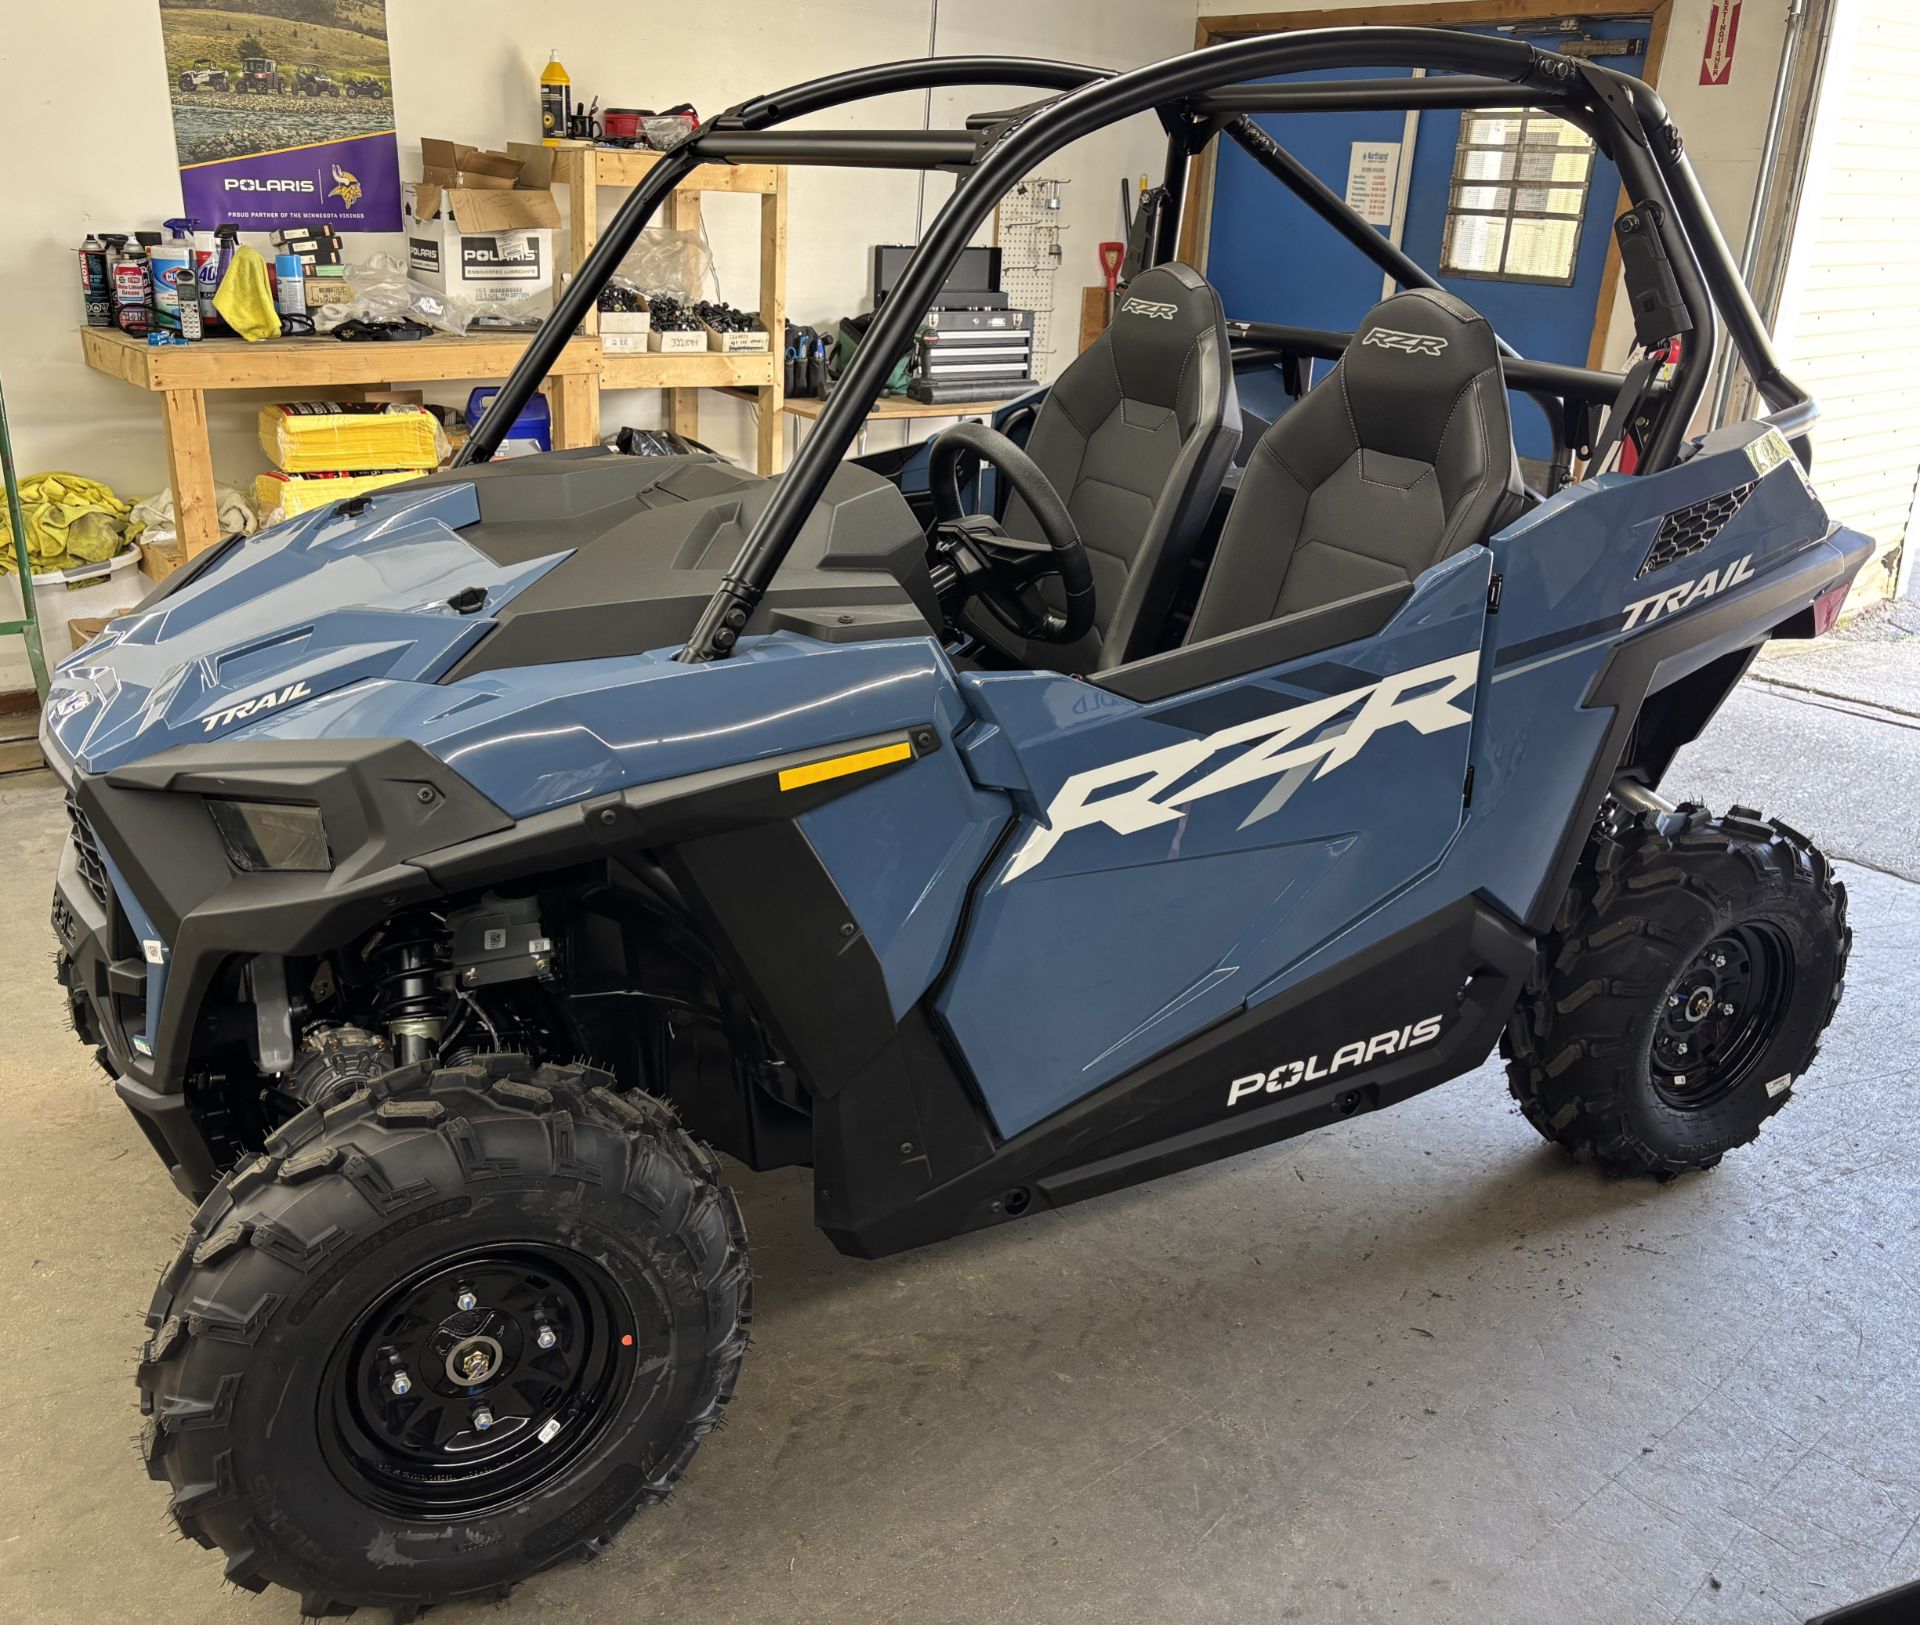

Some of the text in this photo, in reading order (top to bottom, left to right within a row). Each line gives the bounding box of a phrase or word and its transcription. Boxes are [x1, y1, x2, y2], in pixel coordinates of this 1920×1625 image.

[224, 178, 315, 192] POLARIS
[410, 246, 437, 259] POLARIS
[464, 250, 536, 261] POLIS
[1121, 297, 1179, 320] RZR
[1362, 326, 1449, 357] RZR
[1620, 552, 1756, 633] TRAIL
[201, 680, 312, 732] TRAIL
[1000, 649, 1481, 886] RZR
[1226, 1013, 1443, 1107] POLARIS
